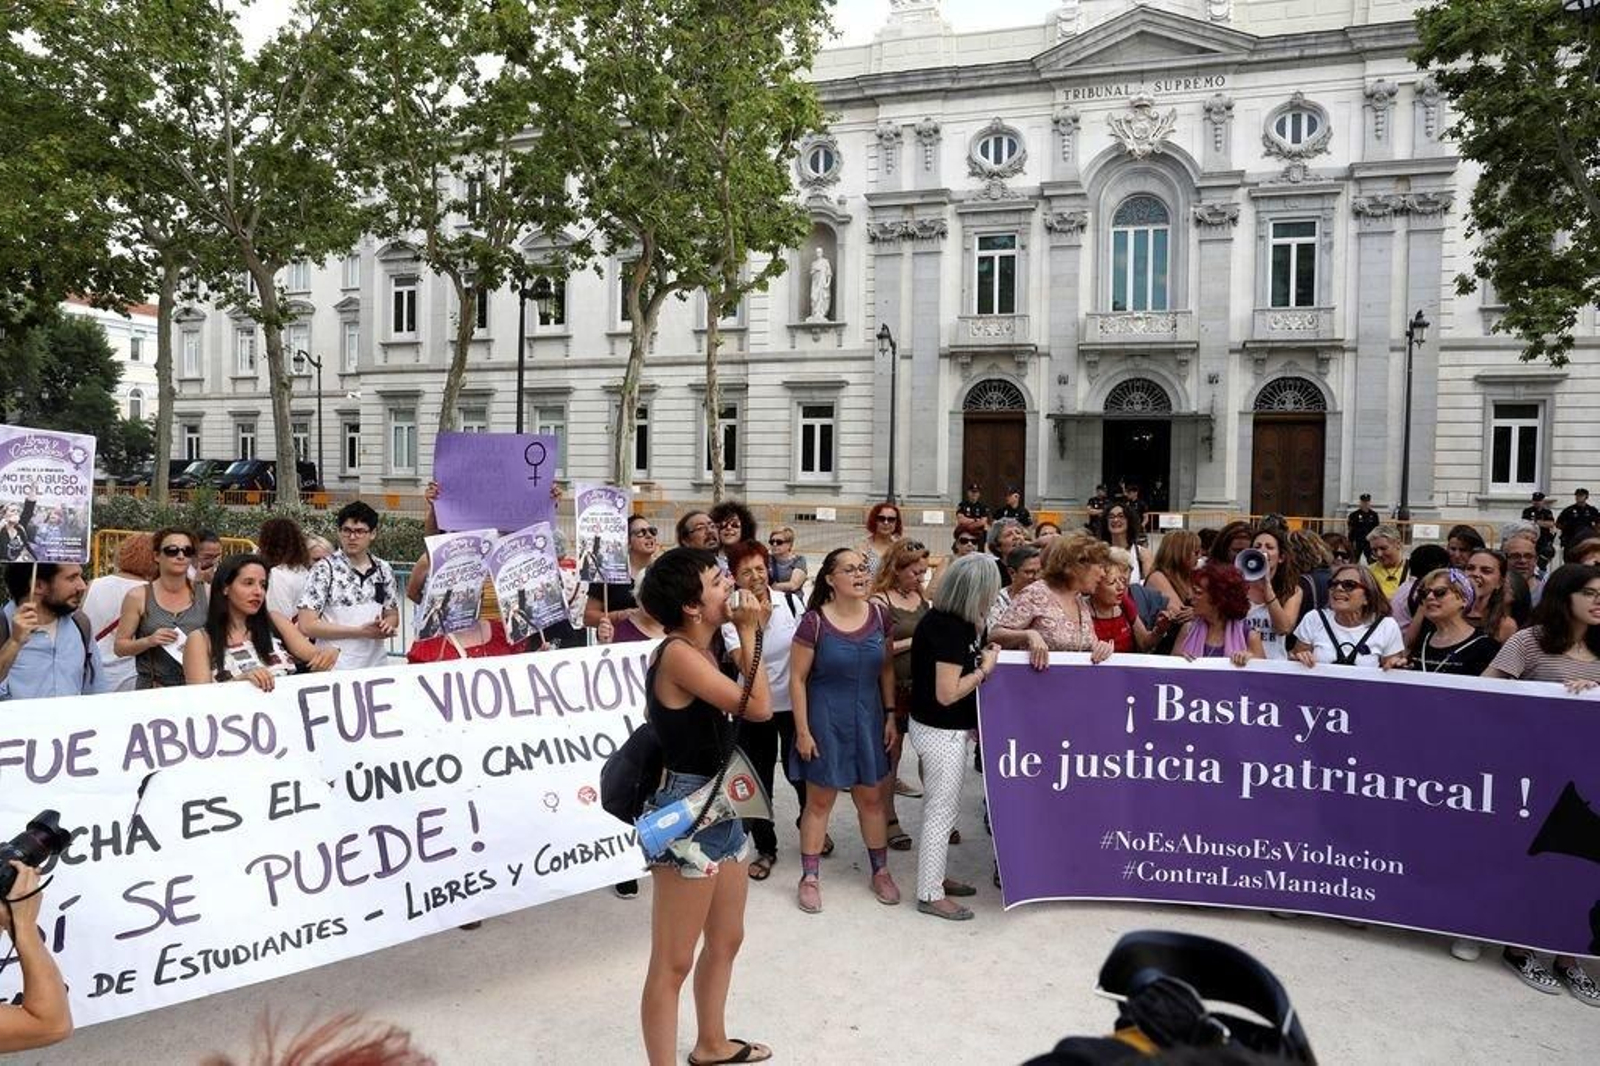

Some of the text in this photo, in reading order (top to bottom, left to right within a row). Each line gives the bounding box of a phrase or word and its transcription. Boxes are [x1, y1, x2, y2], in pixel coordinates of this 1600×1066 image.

[1063, 75, 1226, 100] TRIBUNAL SUPREMO
[36, 474, 79, 486] ABUSO
[123, 712, 288, 771] ABUSO,
[298, 677, 403, 752] FUE
[417, 648, 648, 722] VIOLACIÓN
[1153, 683, 1281, 729] Basta
[1295, 705, 1352, 743] ya
[998, 738, 1042, 779] de
[1052, 741, 1224, 791] justicia
[1241, 757, 1497, 814] patriarcal
[40, 814, 161, 875] CHA
[182, 797, 243, 839] ES
[269, 780, 321, 820] EL
[346, 754, 462, 802] ÚNICO
[1100, 830, 1405, 877] #NoEsAbusoEsViolacion
[1122, 861, 1377, 903] #ContraLasManadas
[87, 969, 137, 998] DE
[533, 828, 637, 878] COMBATIV
[114, 875, 201, 941] SE
